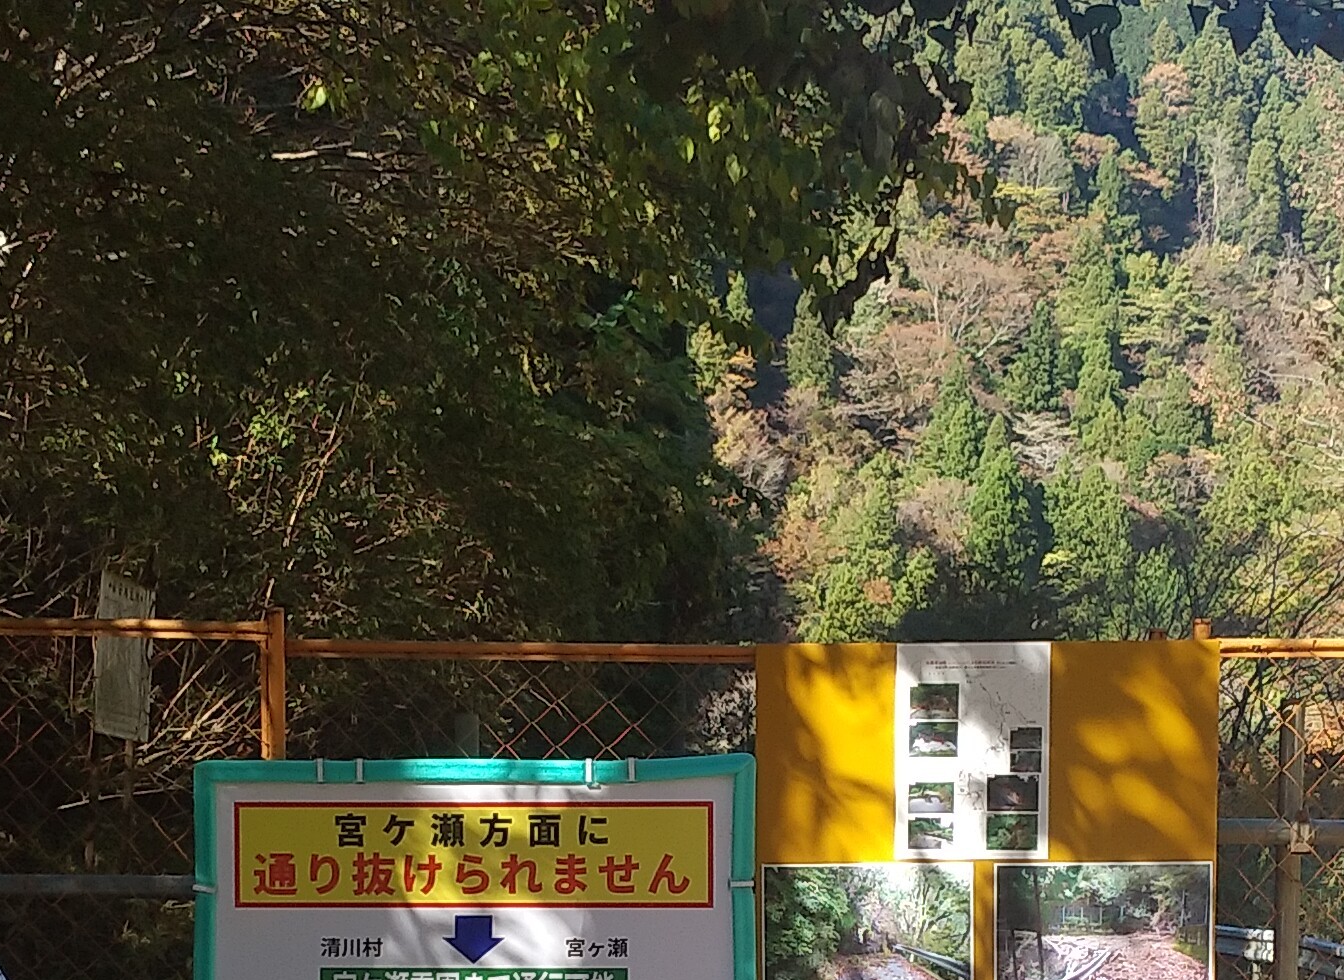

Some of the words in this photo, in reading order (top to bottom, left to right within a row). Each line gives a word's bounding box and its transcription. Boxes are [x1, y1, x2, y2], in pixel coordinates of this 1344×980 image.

[252, 852, 691, 897] 通り抜けられません
[319, 937, 384, 958] 清川村
